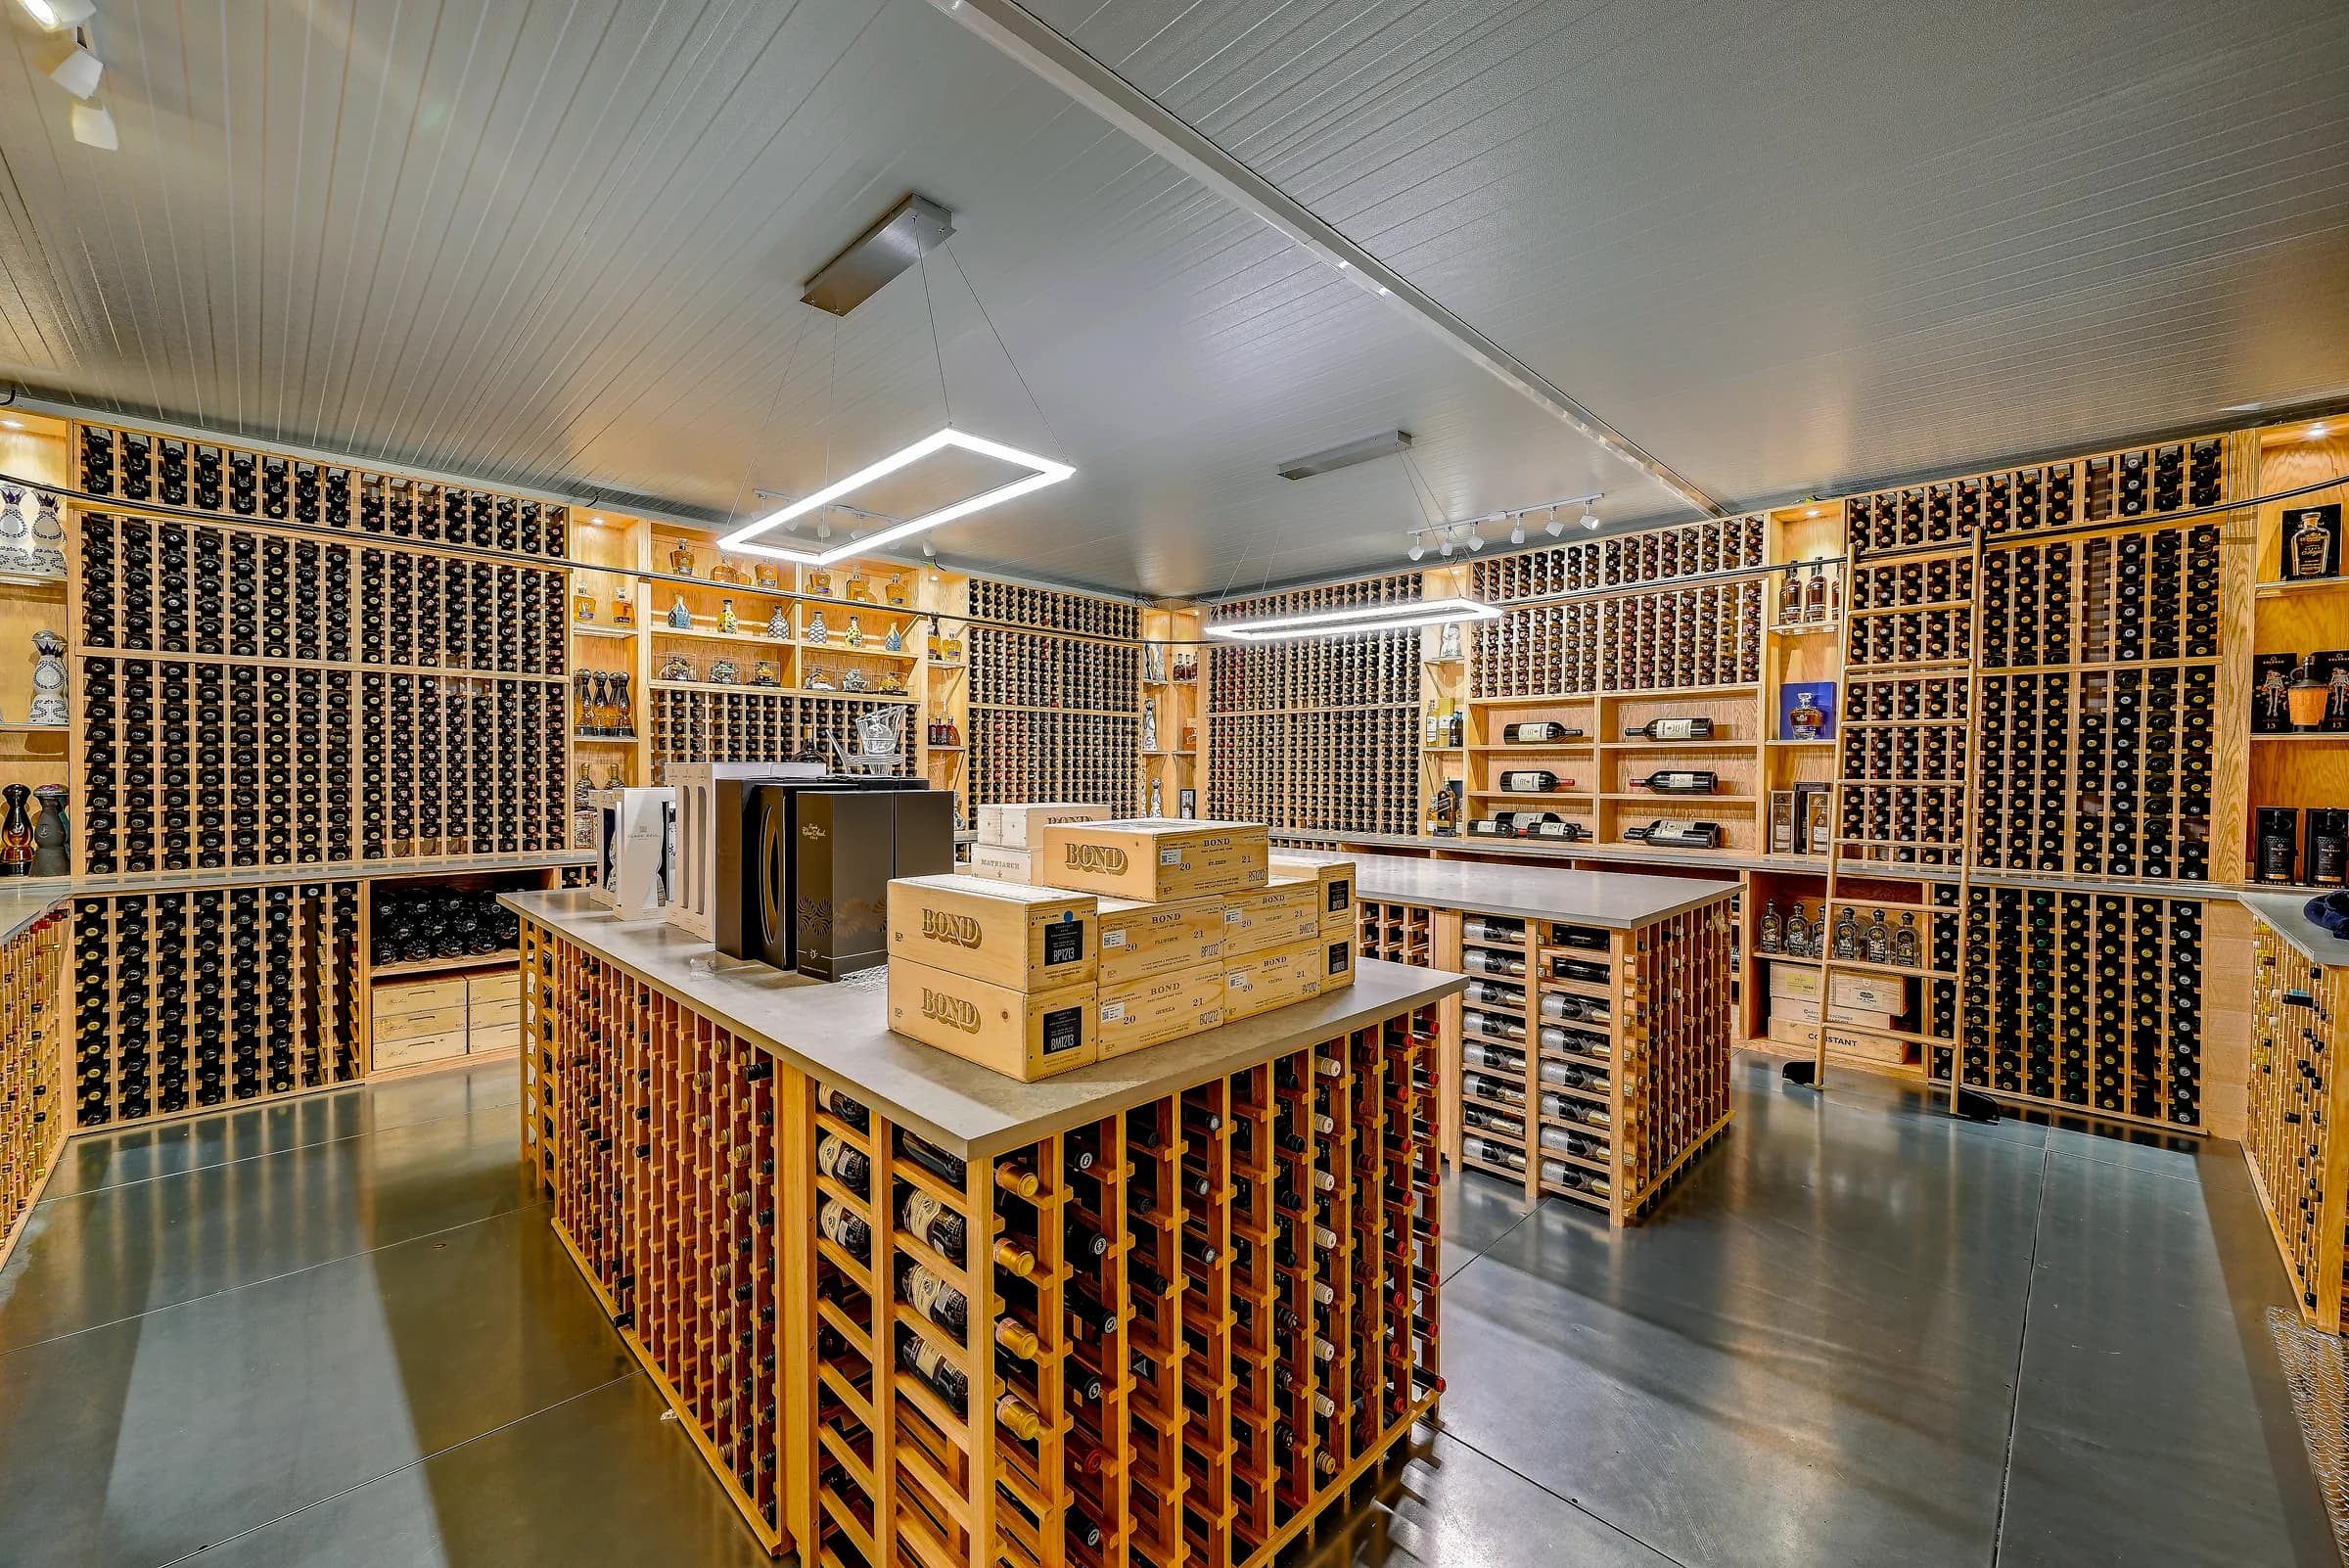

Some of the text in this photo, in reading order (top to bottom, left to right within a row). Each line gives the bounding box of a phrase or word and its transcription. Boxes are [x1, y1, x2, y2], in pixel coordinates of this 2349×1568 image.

[1203, 837, 1230, 848] BOND
[981, 858, 1020, 869] MATRIARCH
[1065, 843, 1128, 876] BOND
[1241, 854, 1252, 863] 21
[1179, 862, 1191, 871] 20
[1262, 895, 1285, 904] BOND
[1151, 912, 1181, 924] BOND
[921, 907, 983, 949] BOND
[1193, 930, 1204, 939] 21
[1125, 943, 1137, 951] 20
[1053, 946, 1075, 962] BP1213
[1264, 956, 1287, 967] BOND
[1150, 982, 1180, 995] BOND
[1192, 997, 1203, 1007] 21
[921, 987, 982, 1035] BOND
[1123, 1015, 1136, 1025] 20
[1050, 1034, 1075, 1051] BM1213
[1808, 1033, 1858, 1047] CSTANT
